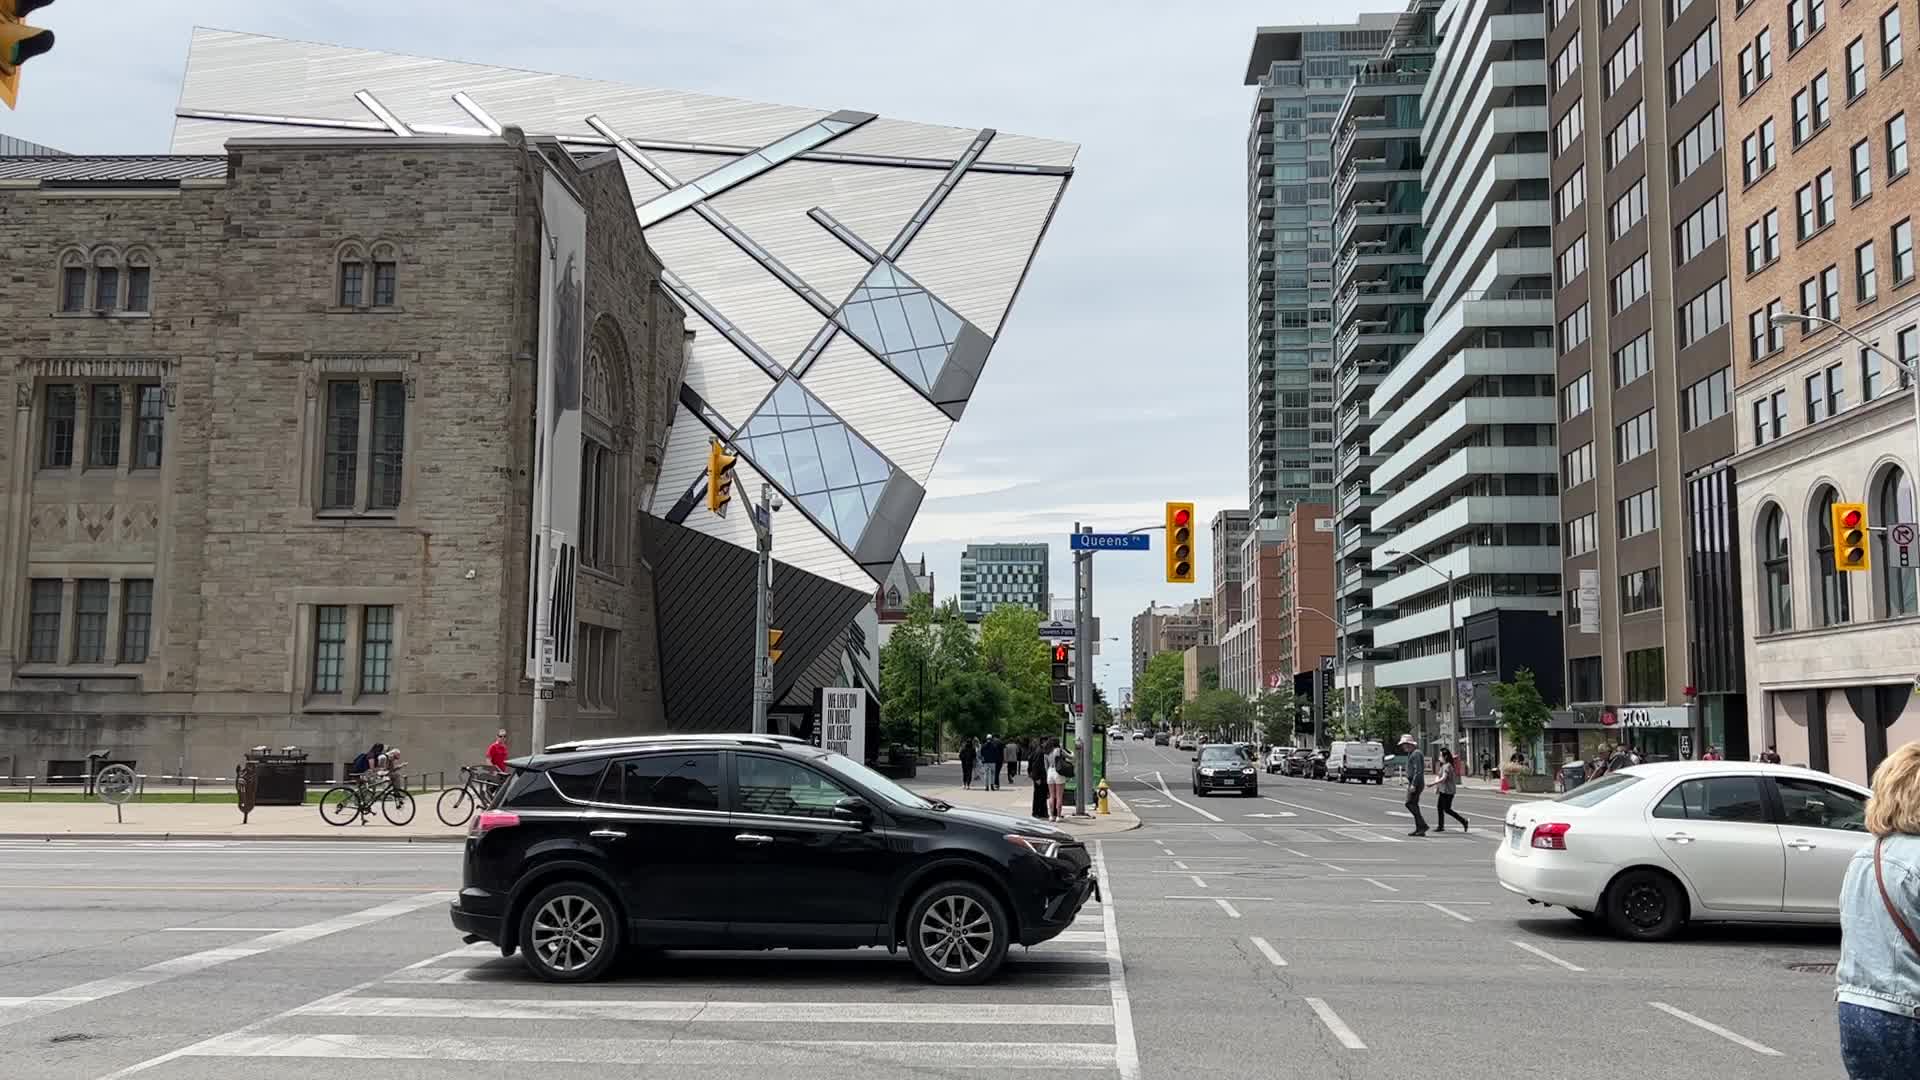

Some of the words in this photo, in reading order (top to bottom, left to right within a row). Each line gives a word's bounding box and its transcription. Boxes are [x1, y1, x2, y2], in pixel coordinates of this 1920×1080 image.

[1081, 535, 1128, 547] Queens
[828, 693, 836, 709] WE
[837, 693, 848, 708] LIVE
[849, 693, 857, 709] ON
[828, 709, 834, 724] IN
[835, 709, 850, 724] WHAT
[827, 725, 835, 740] WE
[836, 725, 852, 740] LEAVE
